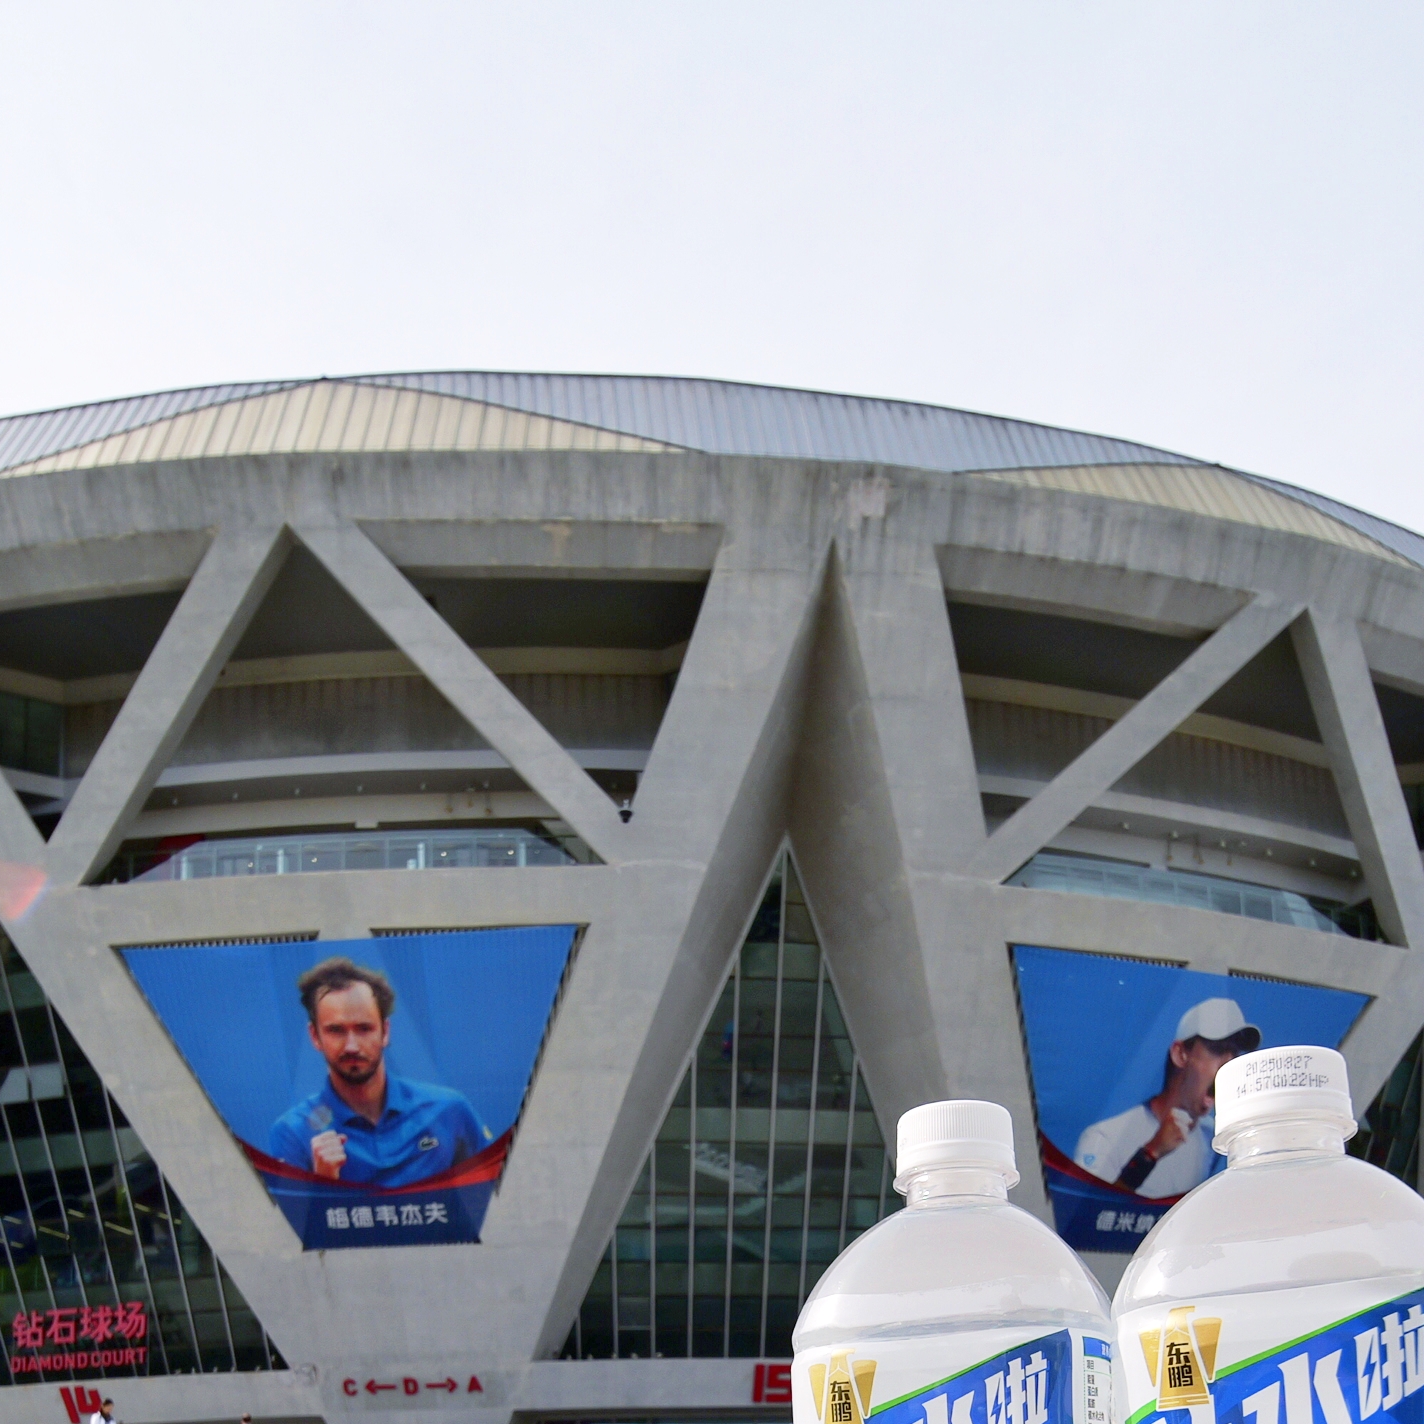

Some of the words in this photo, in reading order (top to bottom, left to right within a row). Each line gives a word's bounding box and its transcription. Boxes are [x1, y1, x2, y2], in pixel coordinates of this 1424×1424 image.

[11, 1301, 148, 1349] 钻石球场
[10, 1351, 88, 1374] DIAMOND
[90, 1346, 148, 1368] COURT
[1165, 1341, 1194, 1389] 东鹏
[343, 1377, 358, 1397] C
[403, 1376, 420, 1396] D
[467, 1374, 483, 1394] A
[829, 1379, 853, 1424] 东鹏
